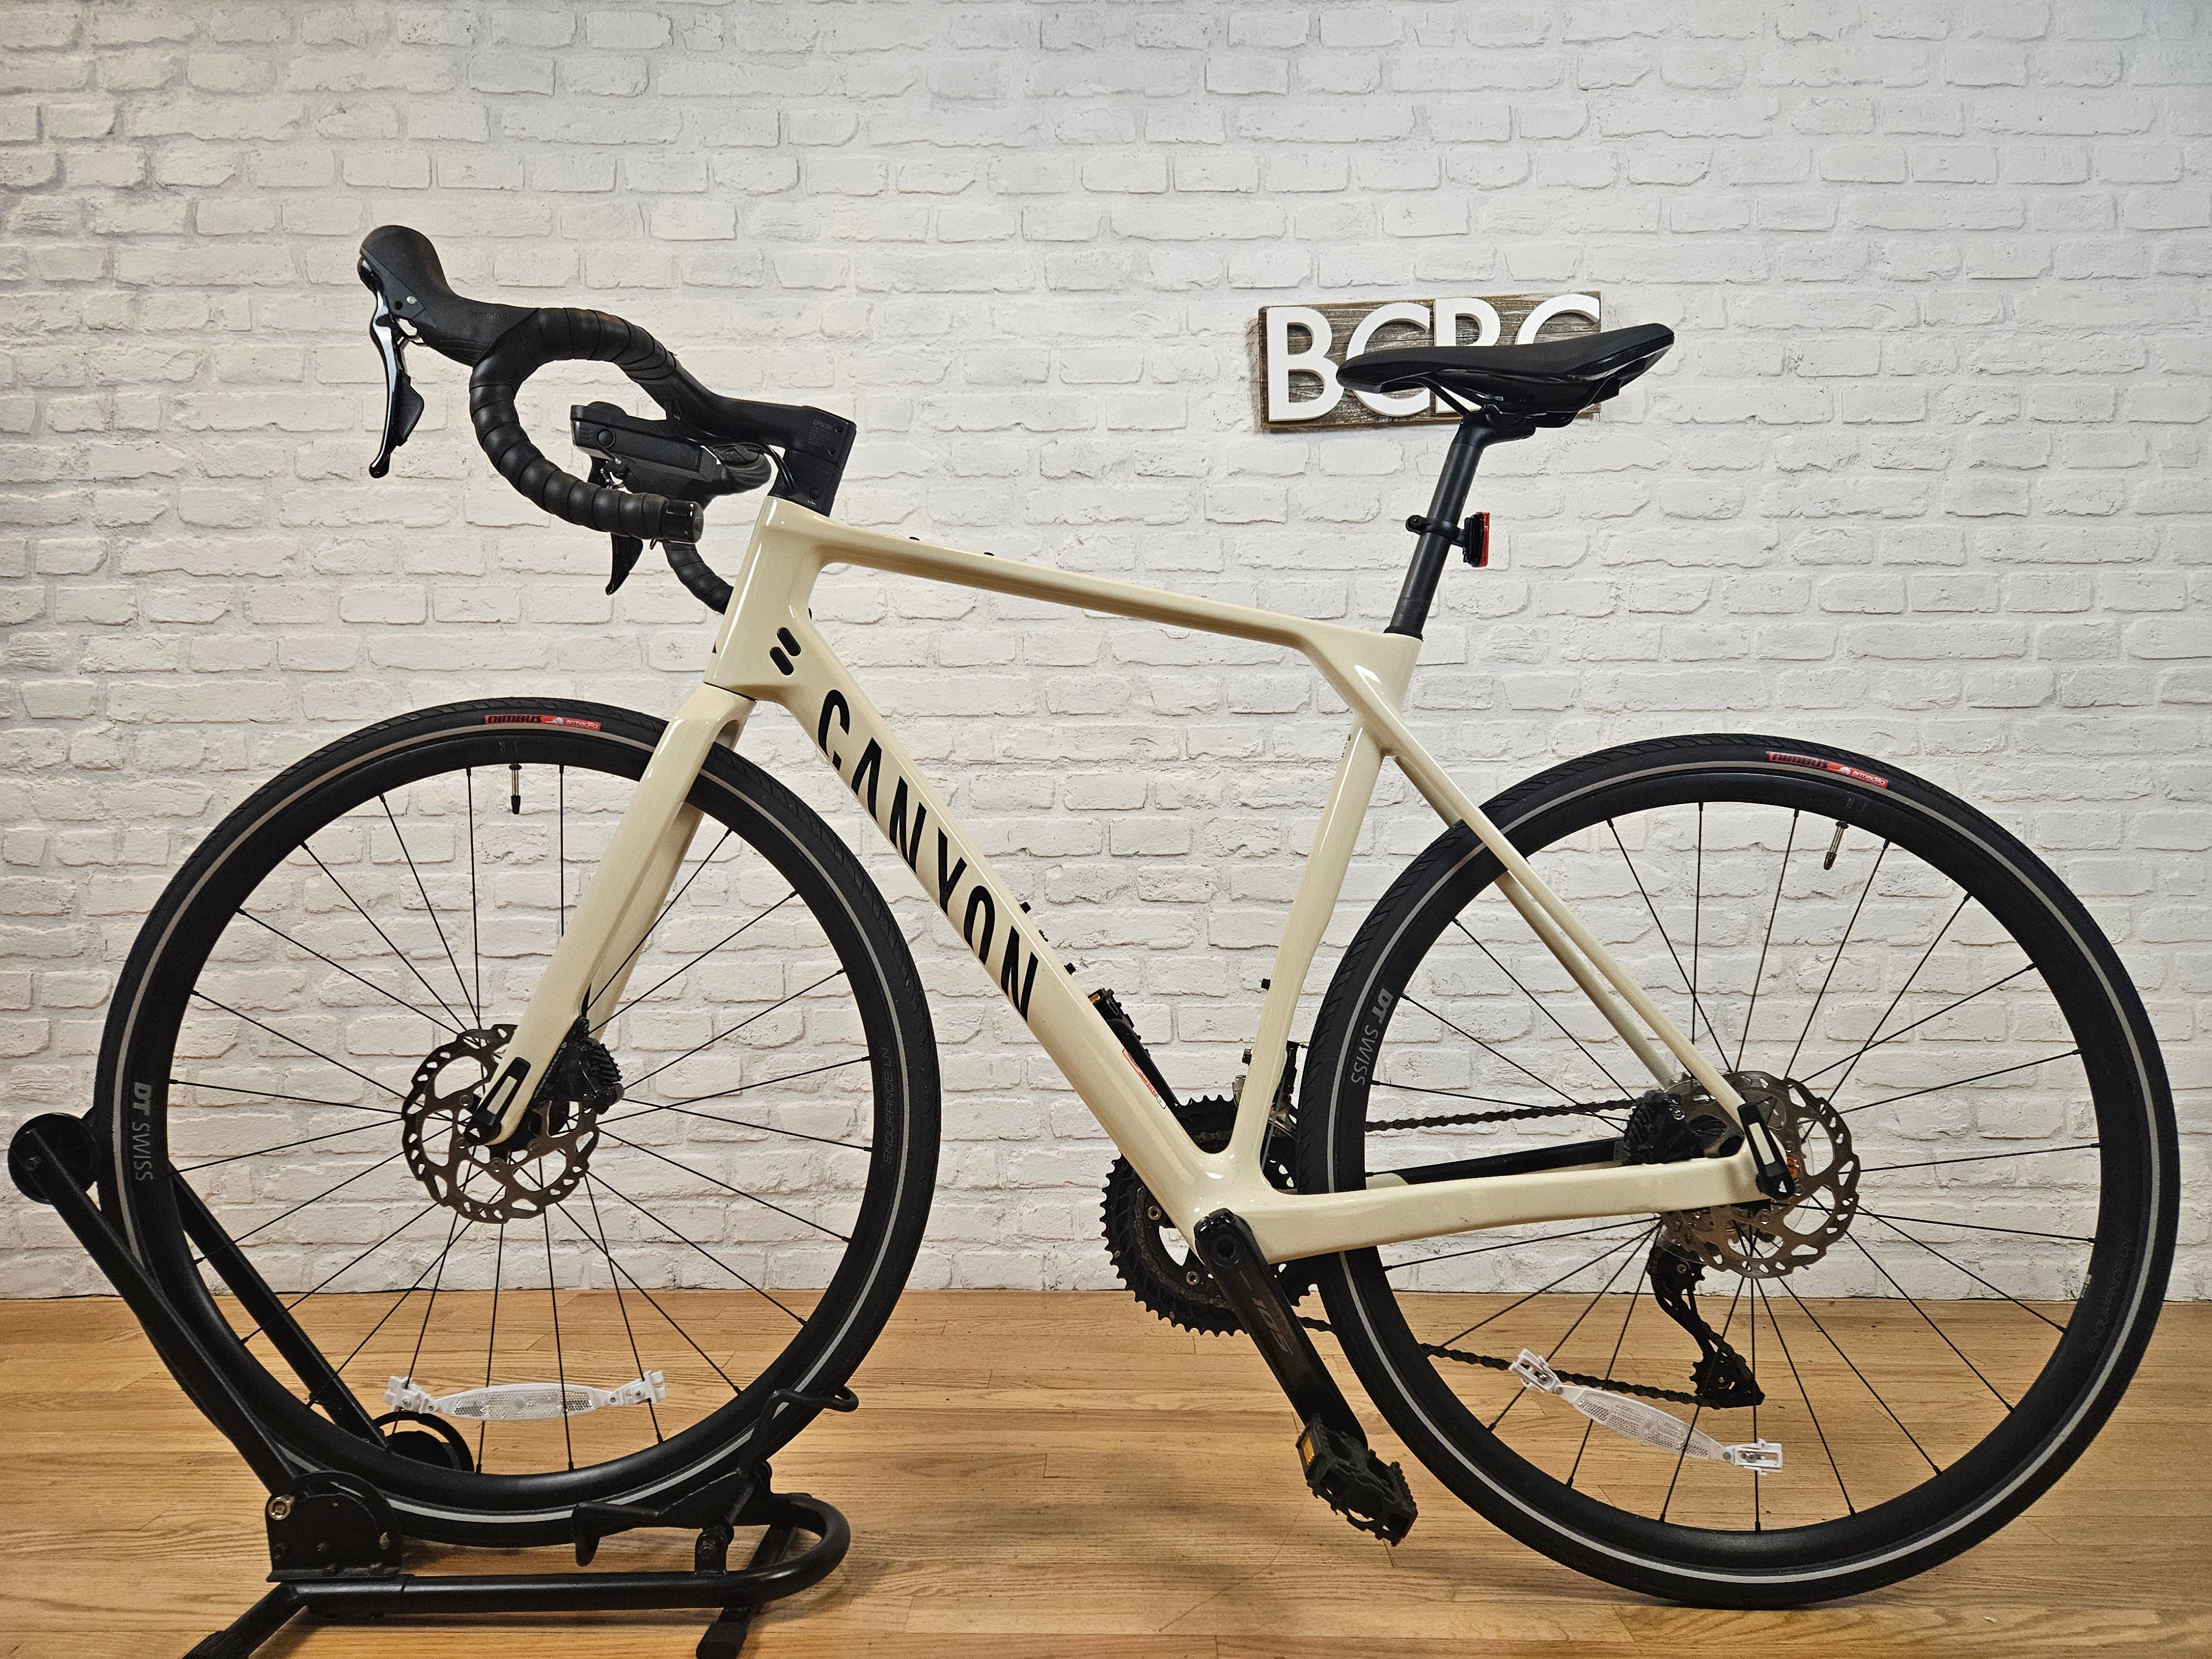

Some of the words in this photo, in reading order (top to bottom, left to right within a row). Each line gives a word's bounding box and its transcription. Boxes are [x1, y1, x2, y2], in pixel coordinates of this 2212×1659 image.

[1852, 770, 1885, 786] armadillo
[817, 689, 1039, 1024] CANYON
[1371, 987, 1394, 1025] DT
[881, 1047, 892, 1067] LN
[1351, 1025, 1379, 1086] SWISS
[132, 1082, 152, 1116] DT
[883, 1070, 894, 1165] ENDURANCE
[131, 1121, 154, 1181] SWISS
[1251, 1297, 1295, 1354] 105
